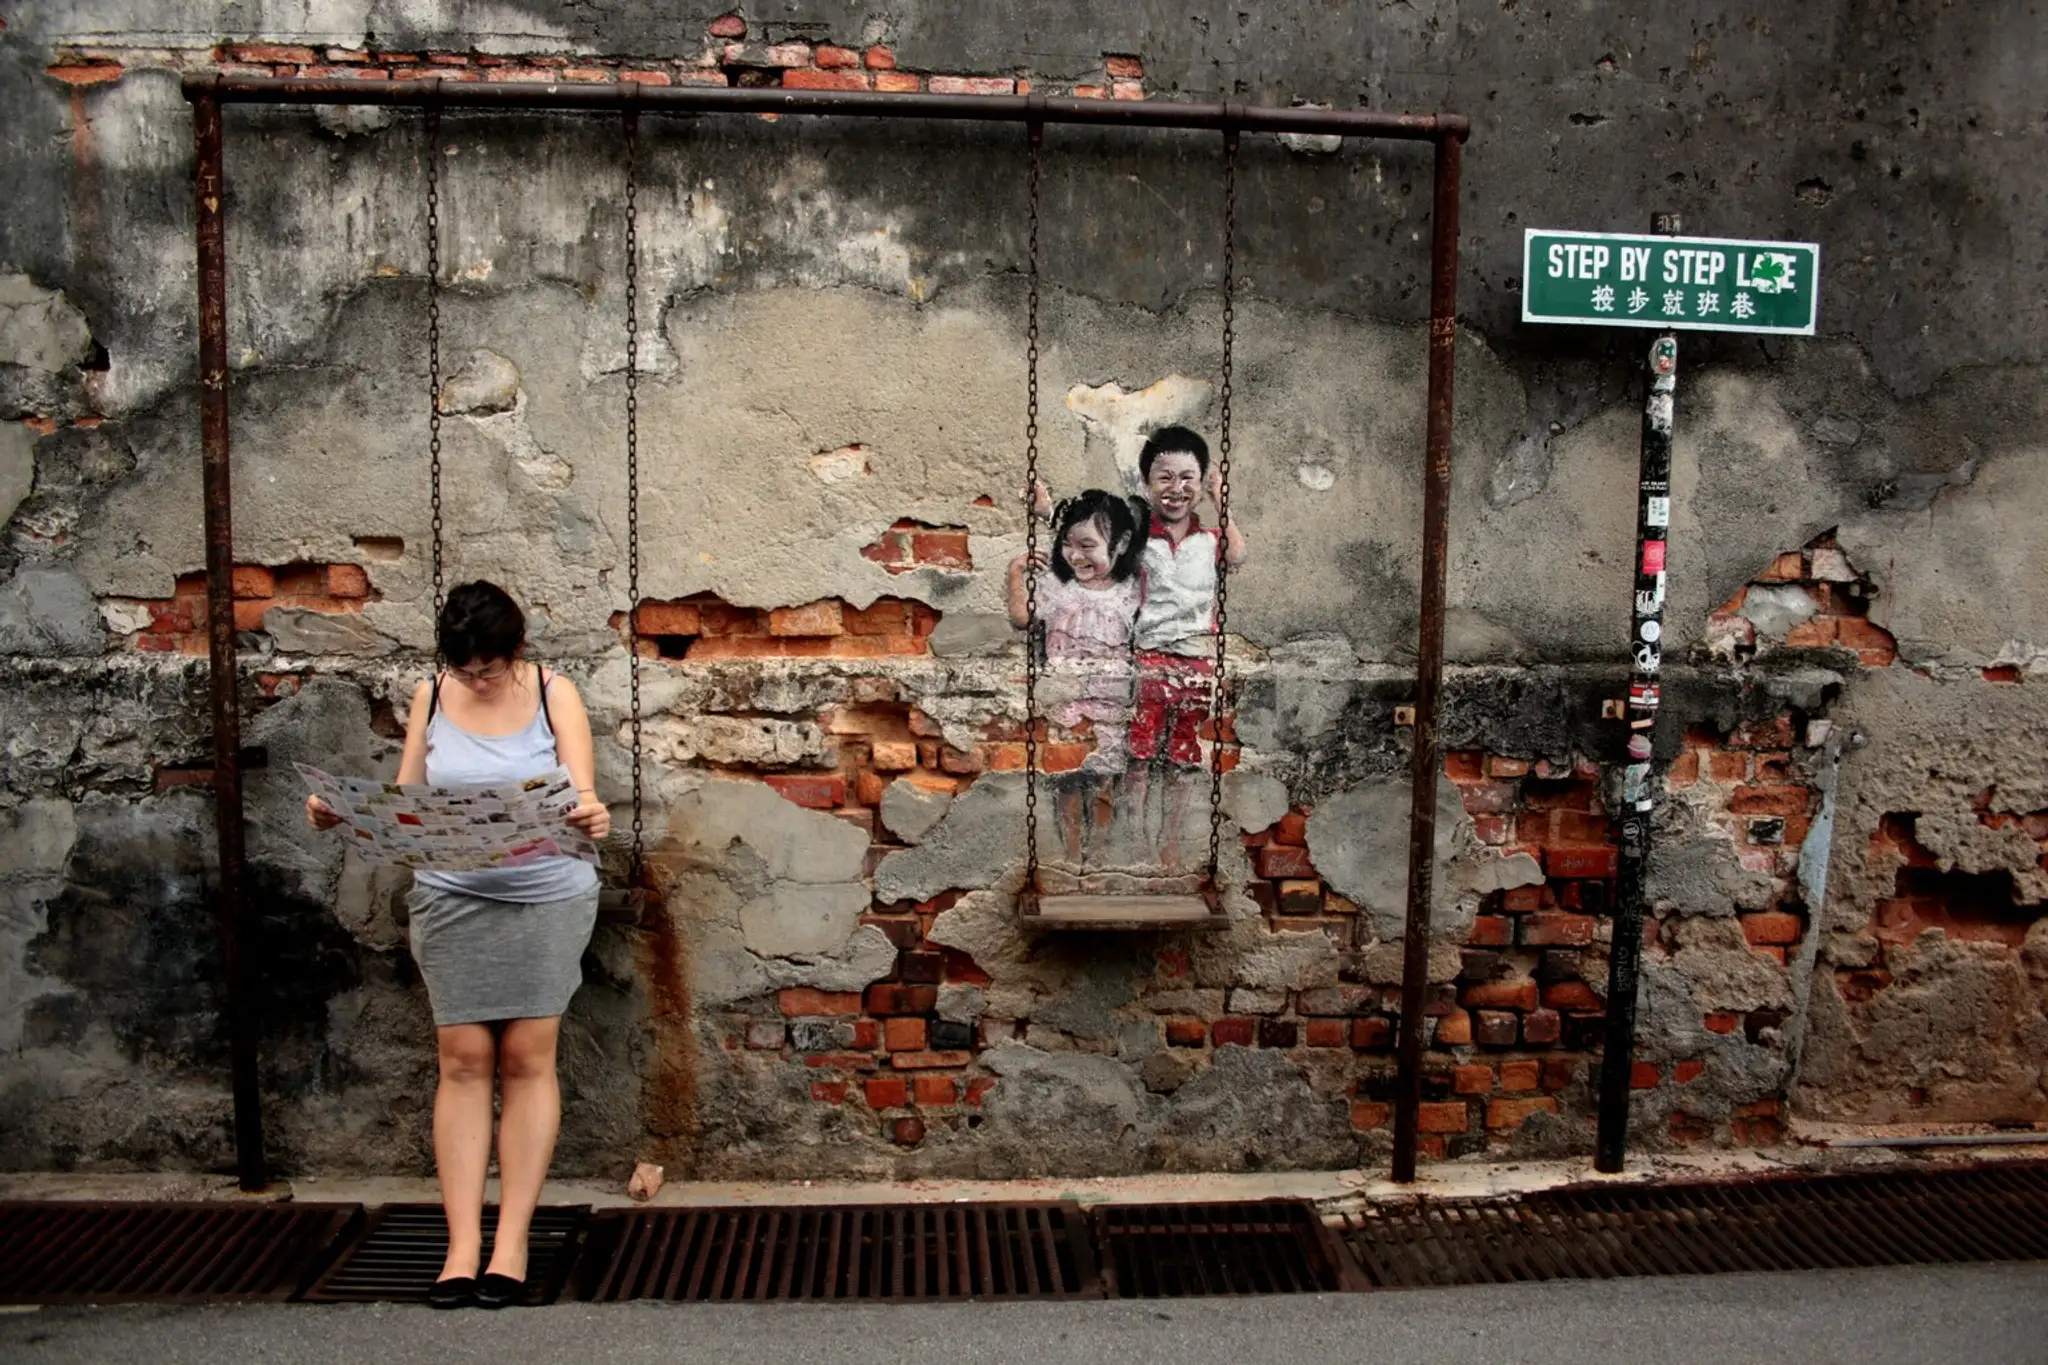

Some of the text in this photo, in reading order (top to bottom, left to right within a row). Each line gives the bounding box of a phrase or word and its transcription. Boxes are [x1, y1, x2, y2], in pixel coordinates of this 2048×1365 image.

[1548, 243, 1610, 280] STEP
[1620, 246, 1652, 282] BY
[1662, 249, 1726, 286] STEP
